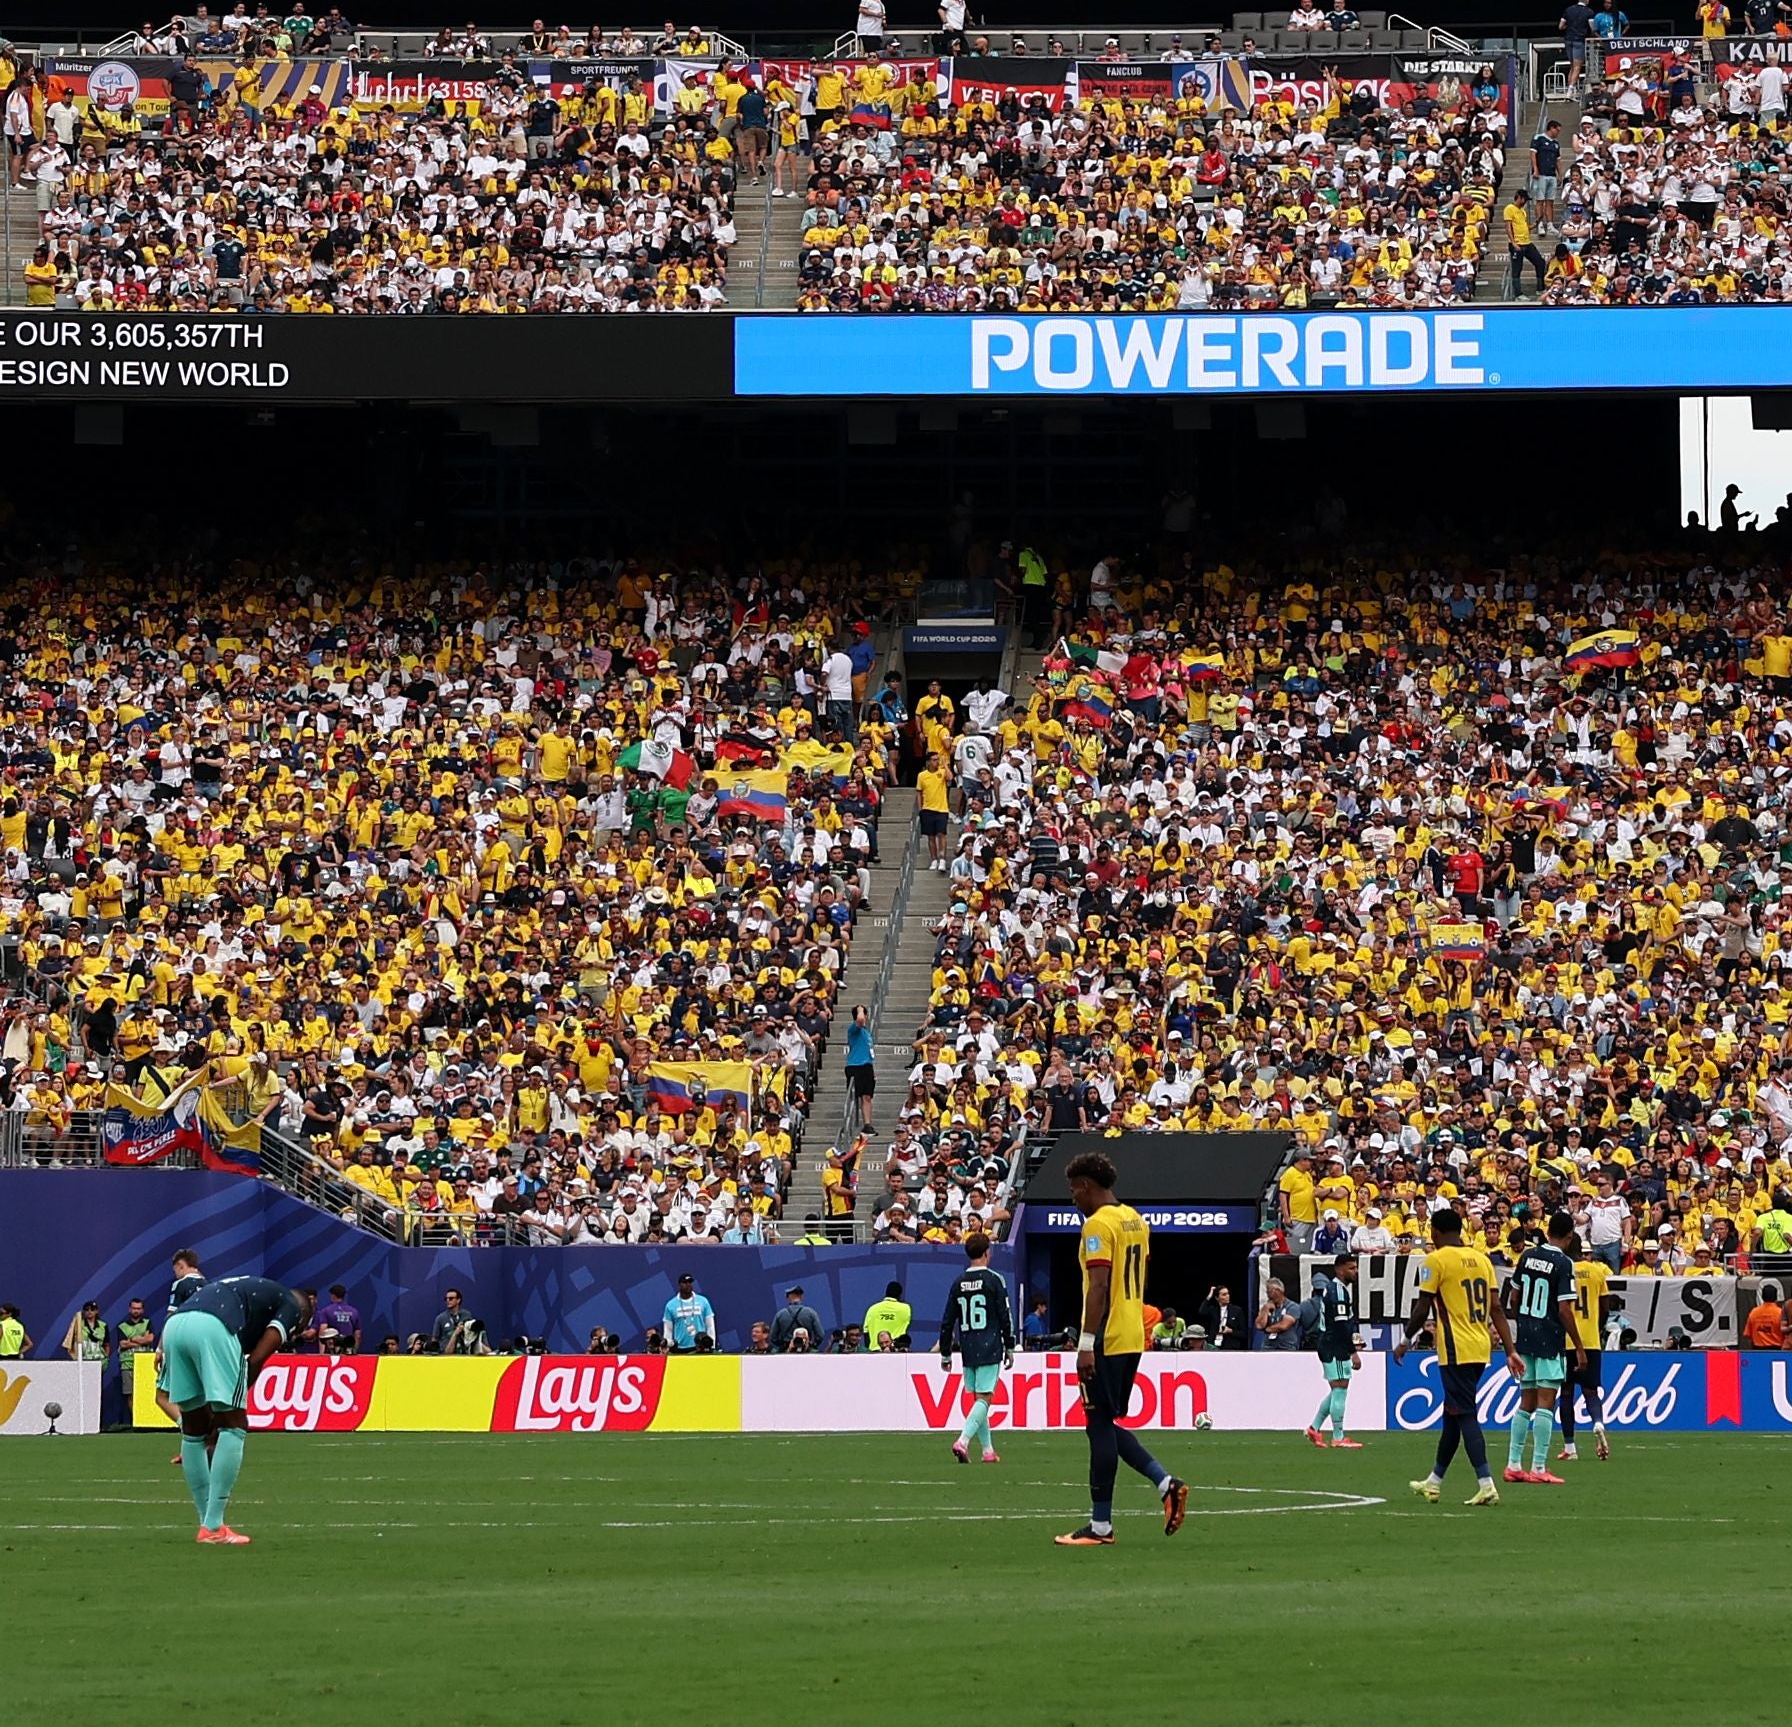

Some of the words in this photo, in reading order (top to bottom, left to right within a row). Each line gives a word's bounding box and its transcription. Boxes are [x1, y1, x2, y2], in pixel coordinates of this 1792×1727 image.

[1610, 38, 1689, 50] DEUTSCHLAND
[55, 61, 93, 73] Müritzer
[1106, 66, 1143, 77] FANCLUB
[1403, 61, 1428, 75] DIE
[15, 321, 82, 348] OUR
[90, 322, 264, 352] 3,605,357TH
[971, 313, 1484, 390] POWERADE
[99, 361, 170, 386] NEW
[178, 361, 289, 388] WORLD
[929, 635, 955, 643] WORLD
[956, 635, 971, 643] CUP
[971, 635, 997, 643] 2026
[965, 745, 976, 760] 6
[1048, 1213, 1081, 1226] FIFA
[1173, 1212, 1228, 1225] 2026
[1125, 1244, 1141, 1300] 11
[1461, 1278, 1488, 1323] 19
[1520, 1273, 1549, 1319] 10
[958, 1294, 987, 1331] 16
[246, 1357, 358, 1431] ay's
[515, 1354, 645, 1432] Lay's
[910, 1352, 1209, 1429] verion
